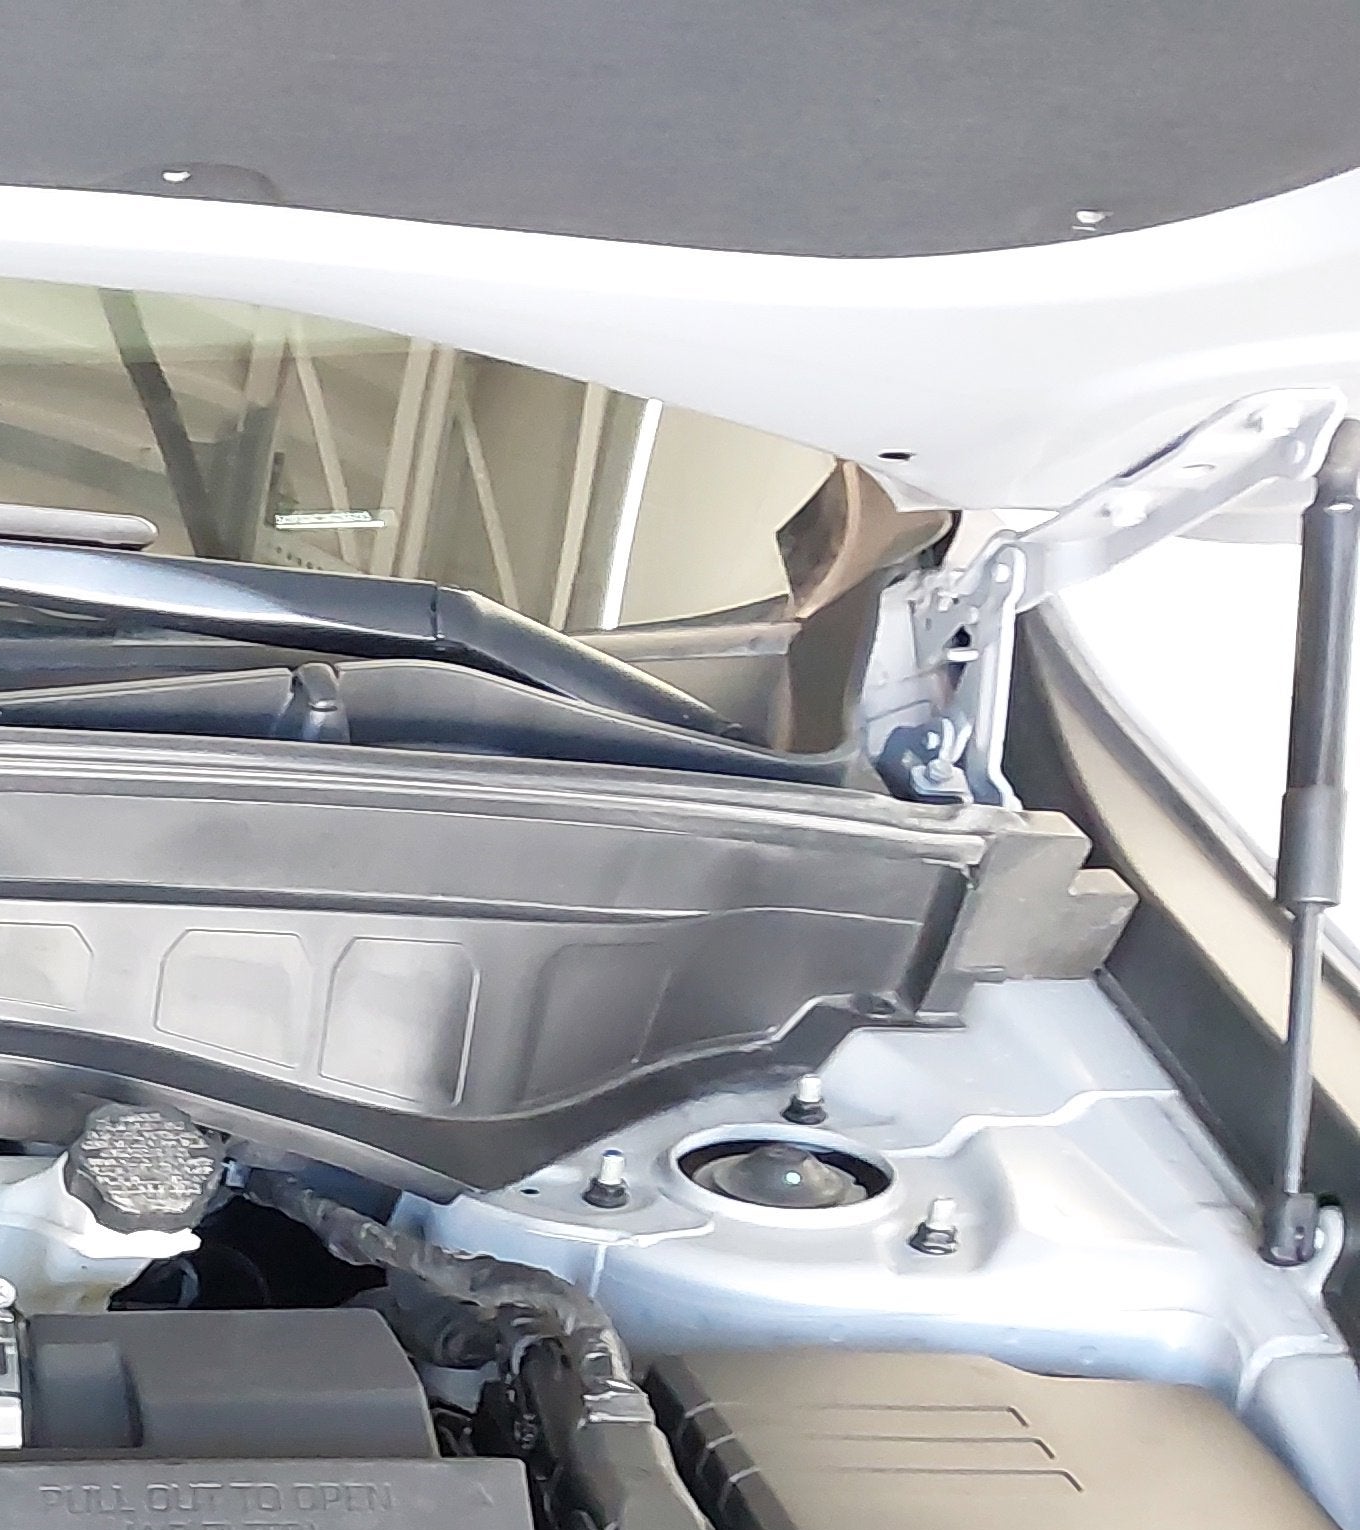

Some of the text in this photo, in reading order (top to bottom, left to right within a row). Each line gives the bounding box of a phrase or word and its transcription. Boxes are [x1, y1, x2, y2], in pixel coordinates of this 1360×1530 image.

[37, 1478, 394, 1515] PULL OUT TO OPEN
